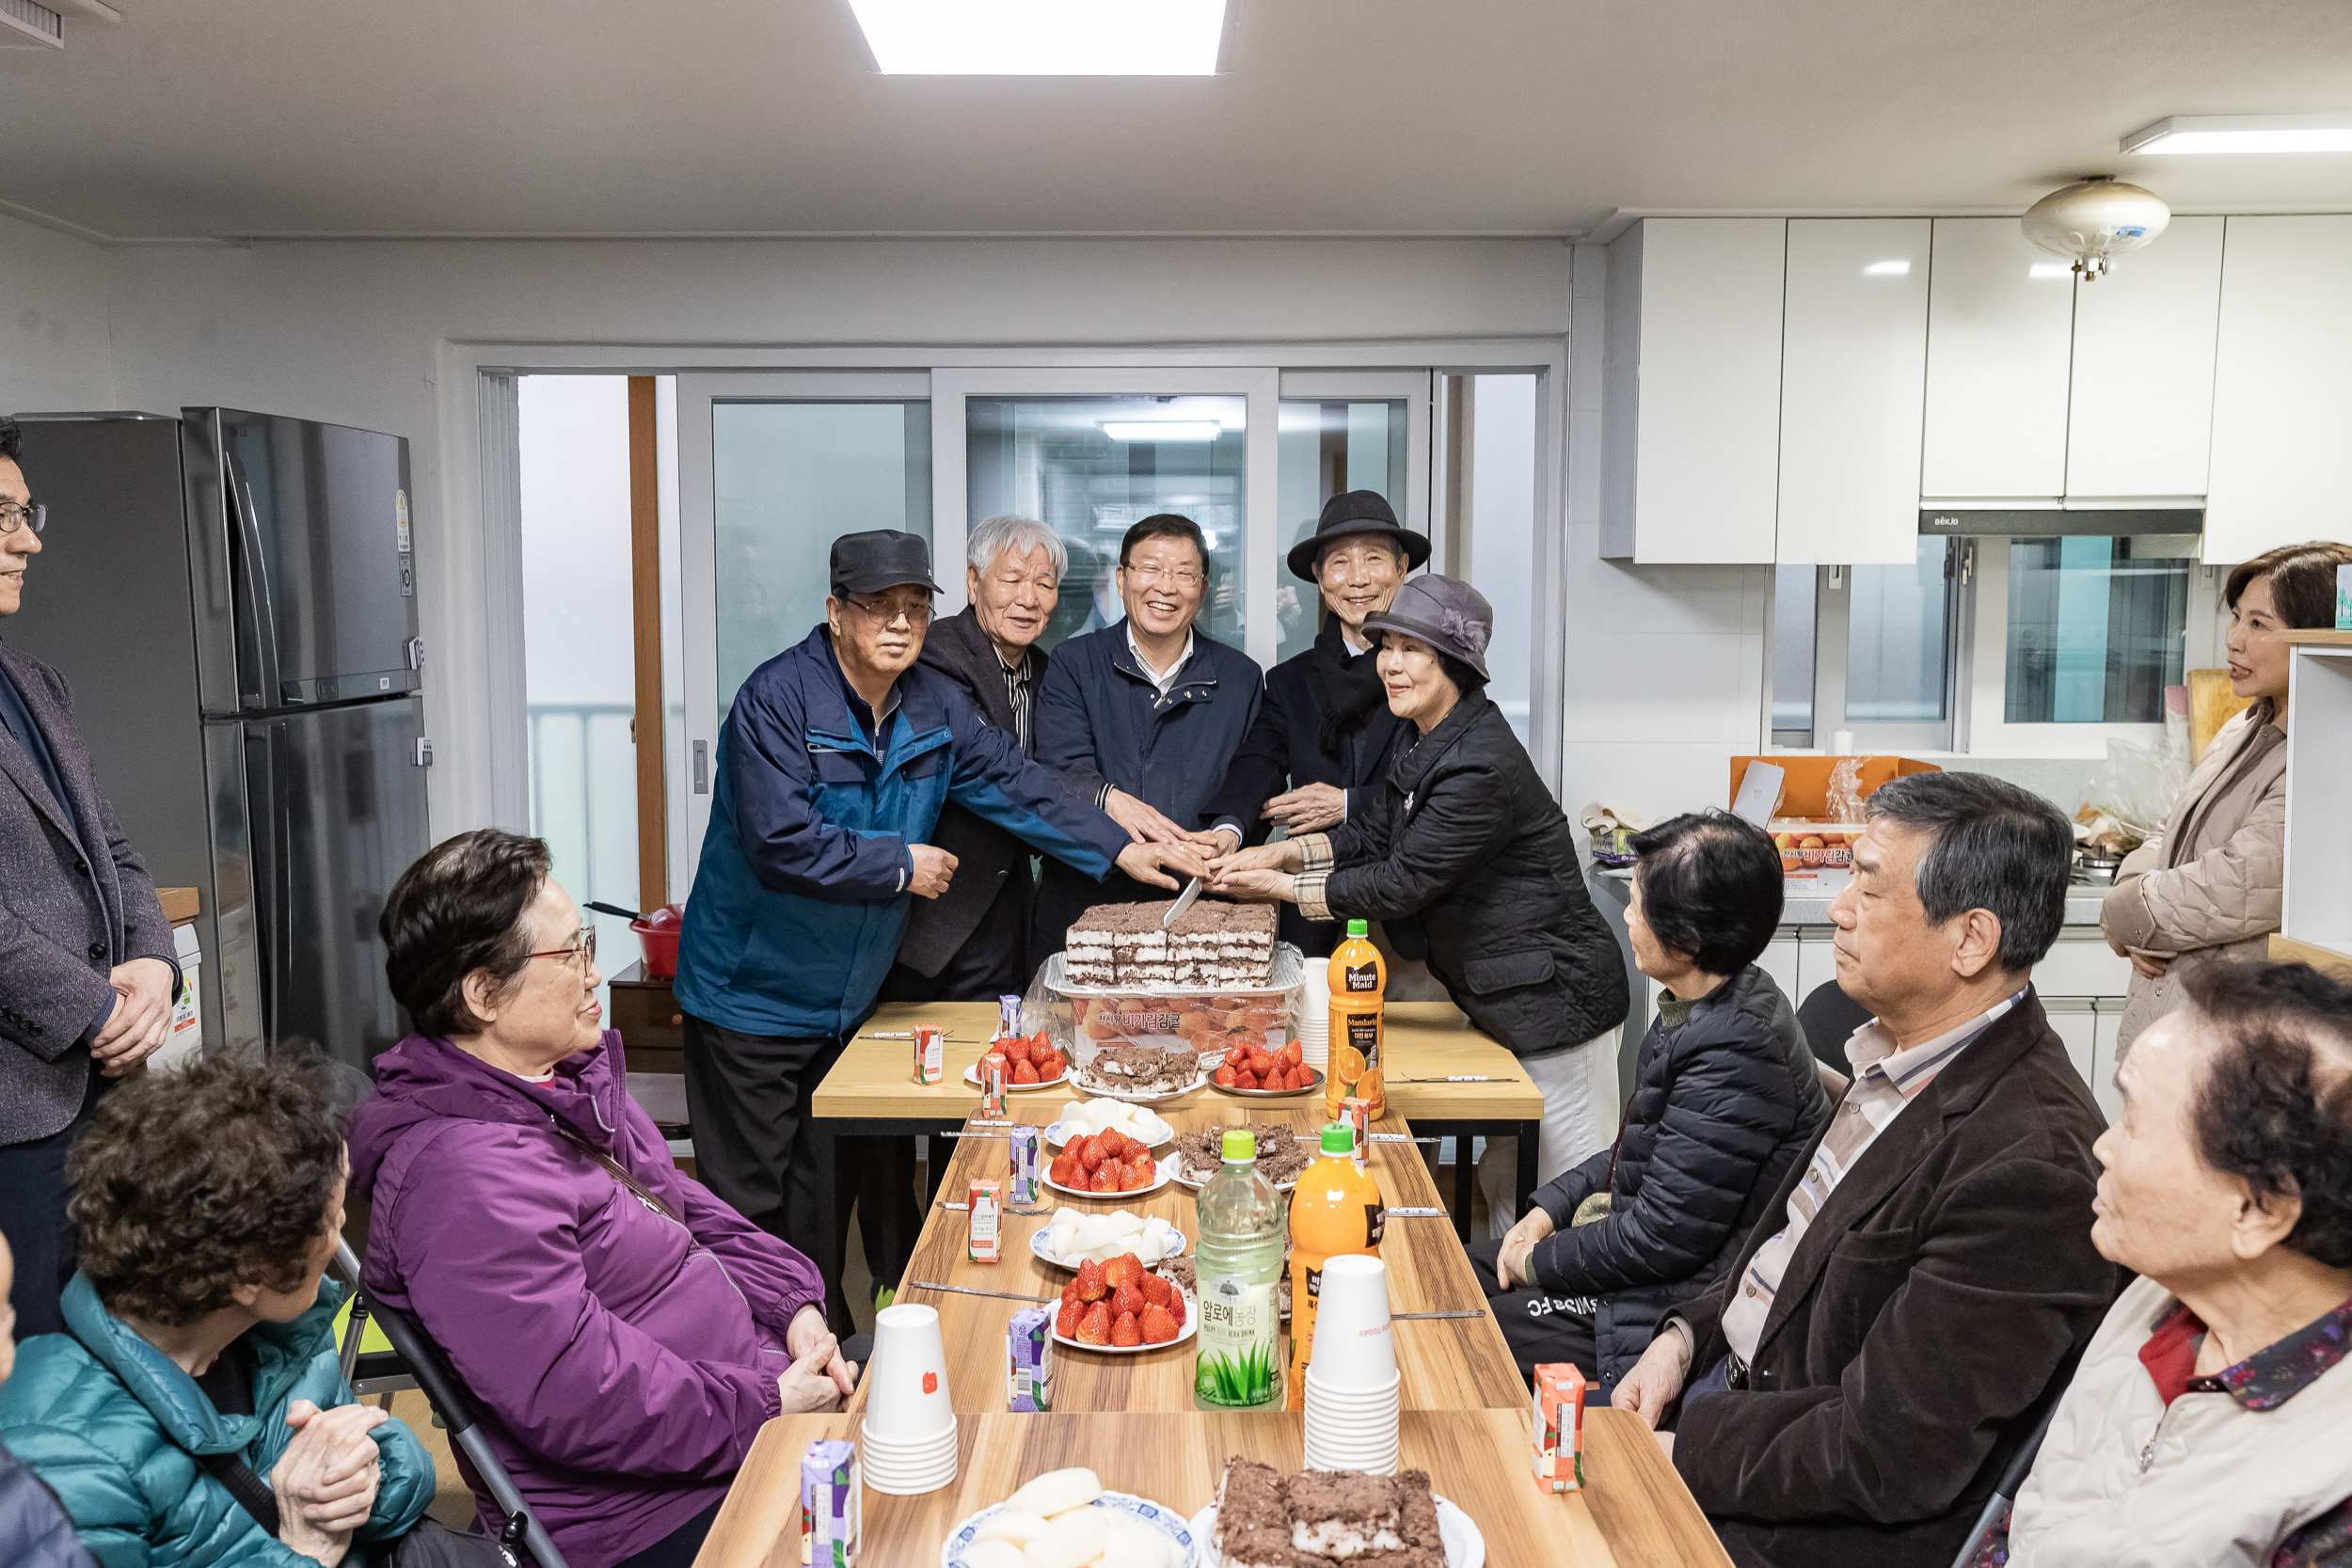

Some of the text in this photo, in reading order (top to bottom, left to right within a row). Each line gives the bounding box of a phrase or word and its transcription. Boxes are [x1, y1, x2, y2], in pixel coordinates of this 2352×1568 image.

[1348, 973, 1375, 982] Minute
[1352, 980, 1373, 989] Maid
[1527, 1296, 1553, 1317] FC
[1203, 1300, 1257, 1327] 알로에농장
[1228, 1329, 1240, 1338] VERA
[1241, 1329, 1256, 1338] DRINK
